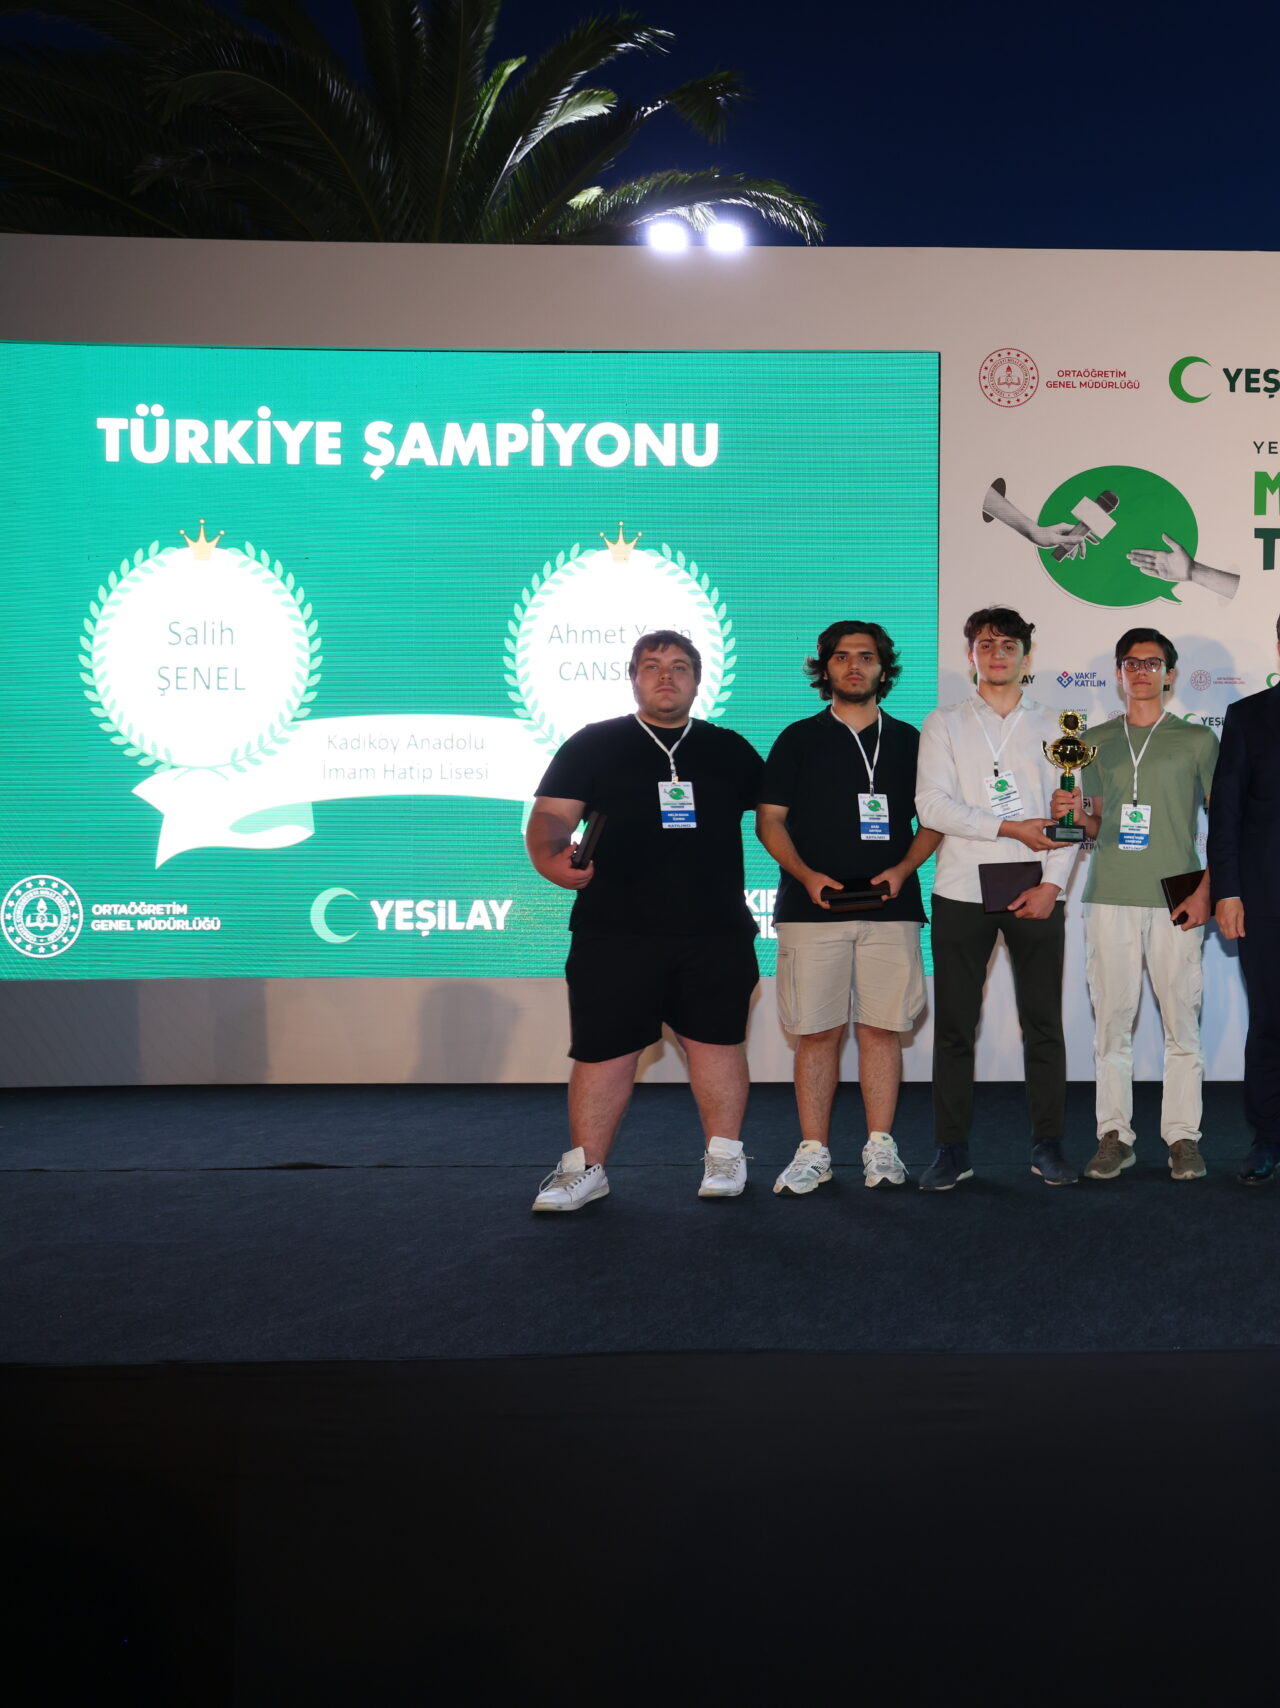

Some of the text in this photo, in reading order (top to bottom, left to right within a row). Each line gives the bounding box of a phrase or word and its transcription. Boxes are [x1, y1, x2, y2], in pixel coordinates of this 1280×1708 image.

[1057, 368, 1127, 378] ORTAÖĞRETİM
[1045, 379, 1140, 390] GENEL MÜDÜRLÜĞÜ
[96, 403, 720, 480] TÜRKİYE ŞAMPİYONU
[167, 620, 235, 647] Salih
[548, 623, 626, 644] Ahmet
[157, 665, 246, 696] ŞENEL
[1074, 672, 1097, 680] VAKIF
[1074, 680, 1106, 688] KATILIM
[406, 733, 485, 751] Anadolu
[383, 762, 433, 783] Hatip
[440, 762, 489, 780] Lisesi
[91, 901, 188, 916] ORTAÖĞRETİM
[90, 917, 221, 931] GENEL MÜDÜRLÜĞÜ
